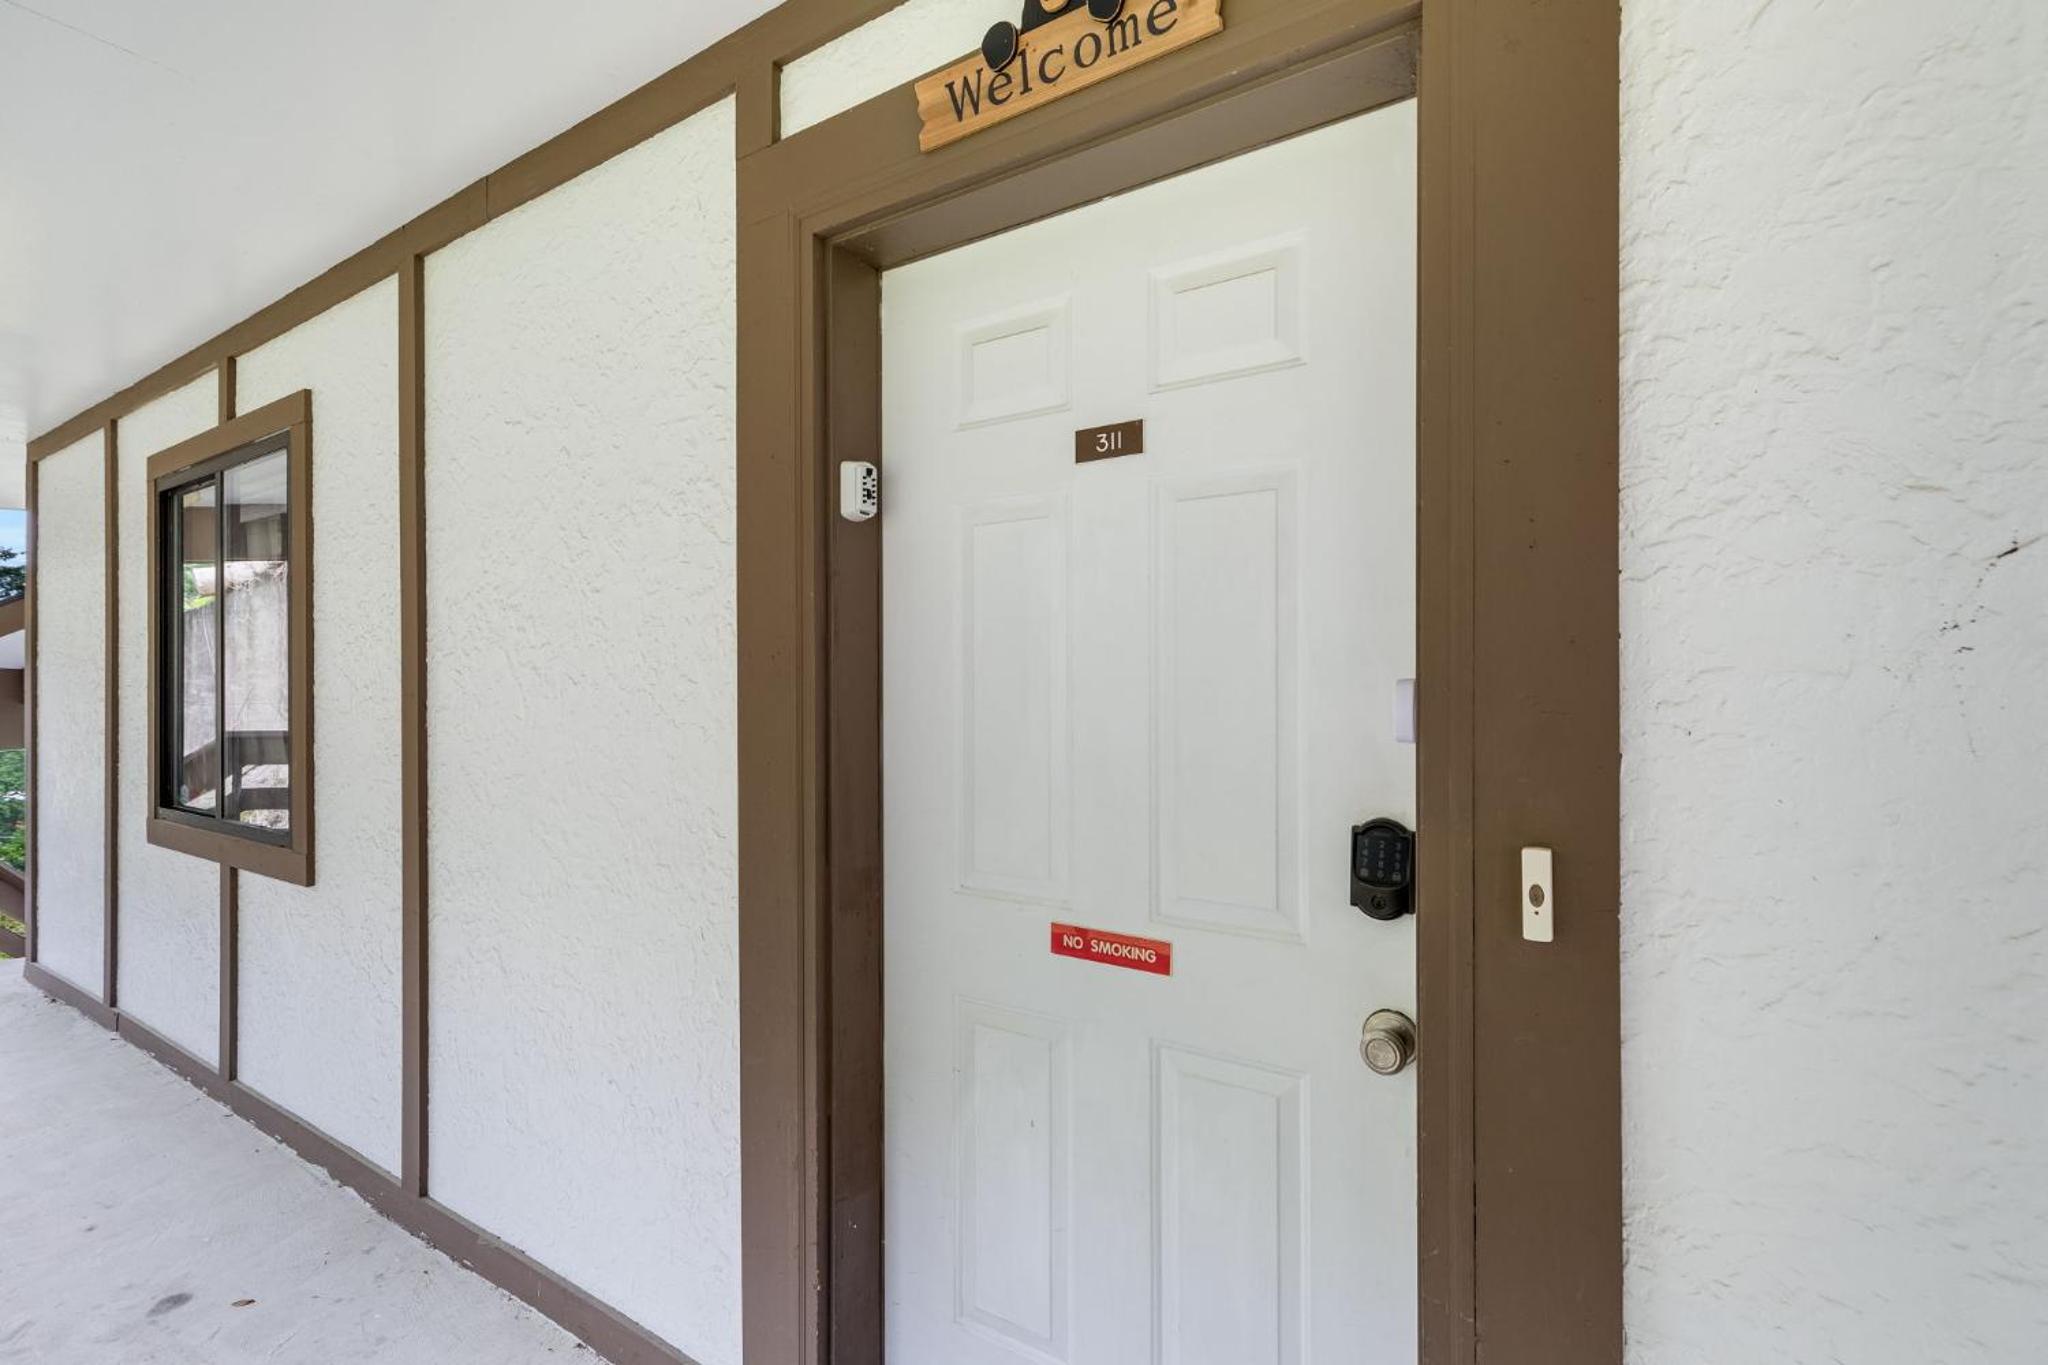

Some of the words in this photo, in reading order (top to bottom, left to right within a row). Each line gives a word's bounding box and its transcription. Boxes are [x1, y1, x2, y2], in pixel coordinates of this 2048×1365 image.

[944, 0, 1178, 122] Welcome
[1095, 431, 1122, 452] 311
[1062, 934, 1083, 949] NO
[1090, 939, 1157, 963] SMOKING
